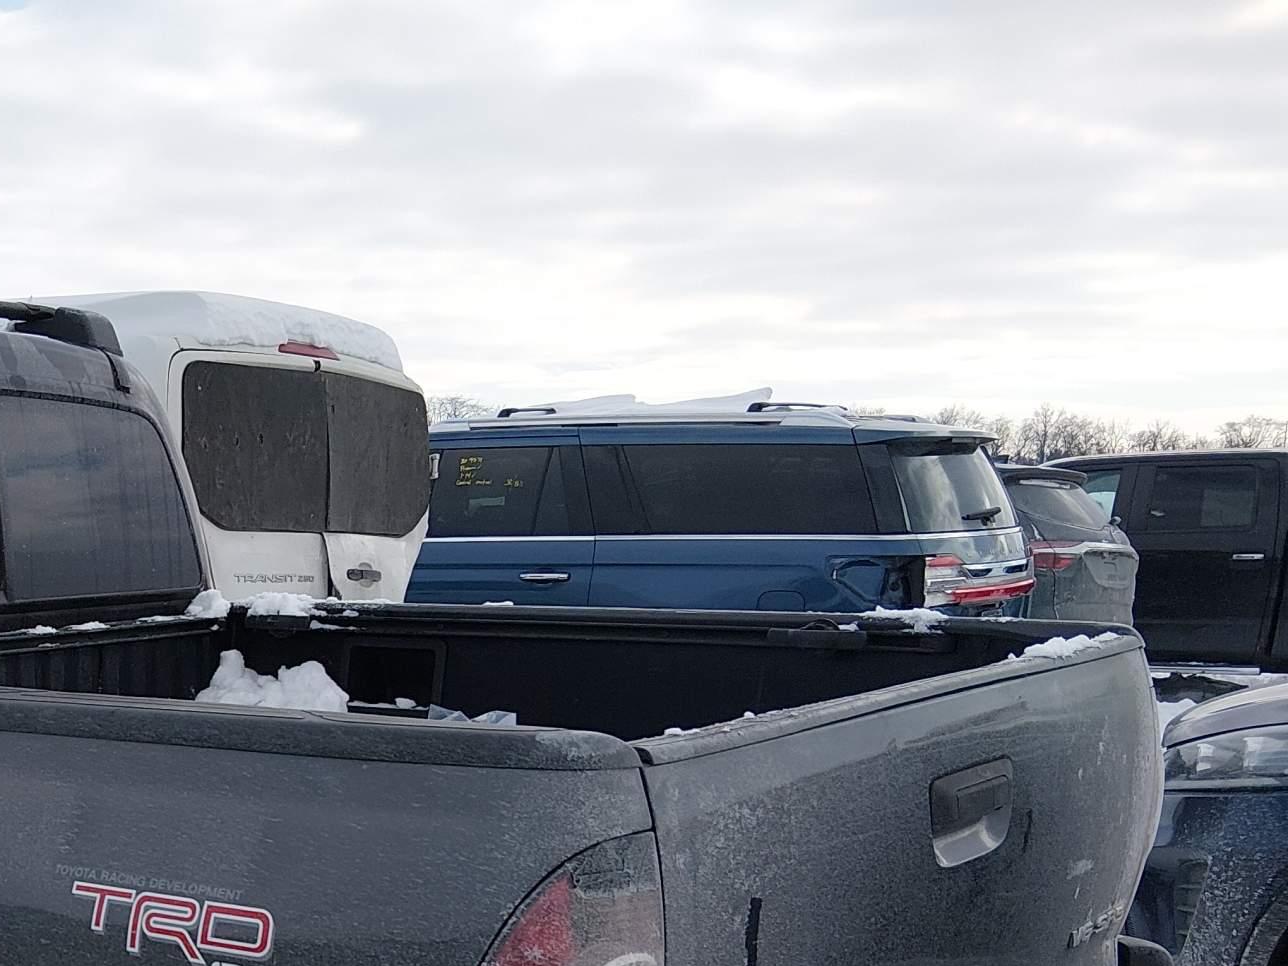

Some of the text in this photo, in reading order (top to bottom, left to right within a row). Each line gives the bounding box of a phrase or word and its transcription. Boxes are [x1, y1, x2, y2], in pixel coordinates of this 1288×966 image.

[233, 573, 296, 584] TRANSIT
[55, 864, 244, 900] TOYOTA RACING DEVELOPMENT
[71, 880, 274, 965] TRD
